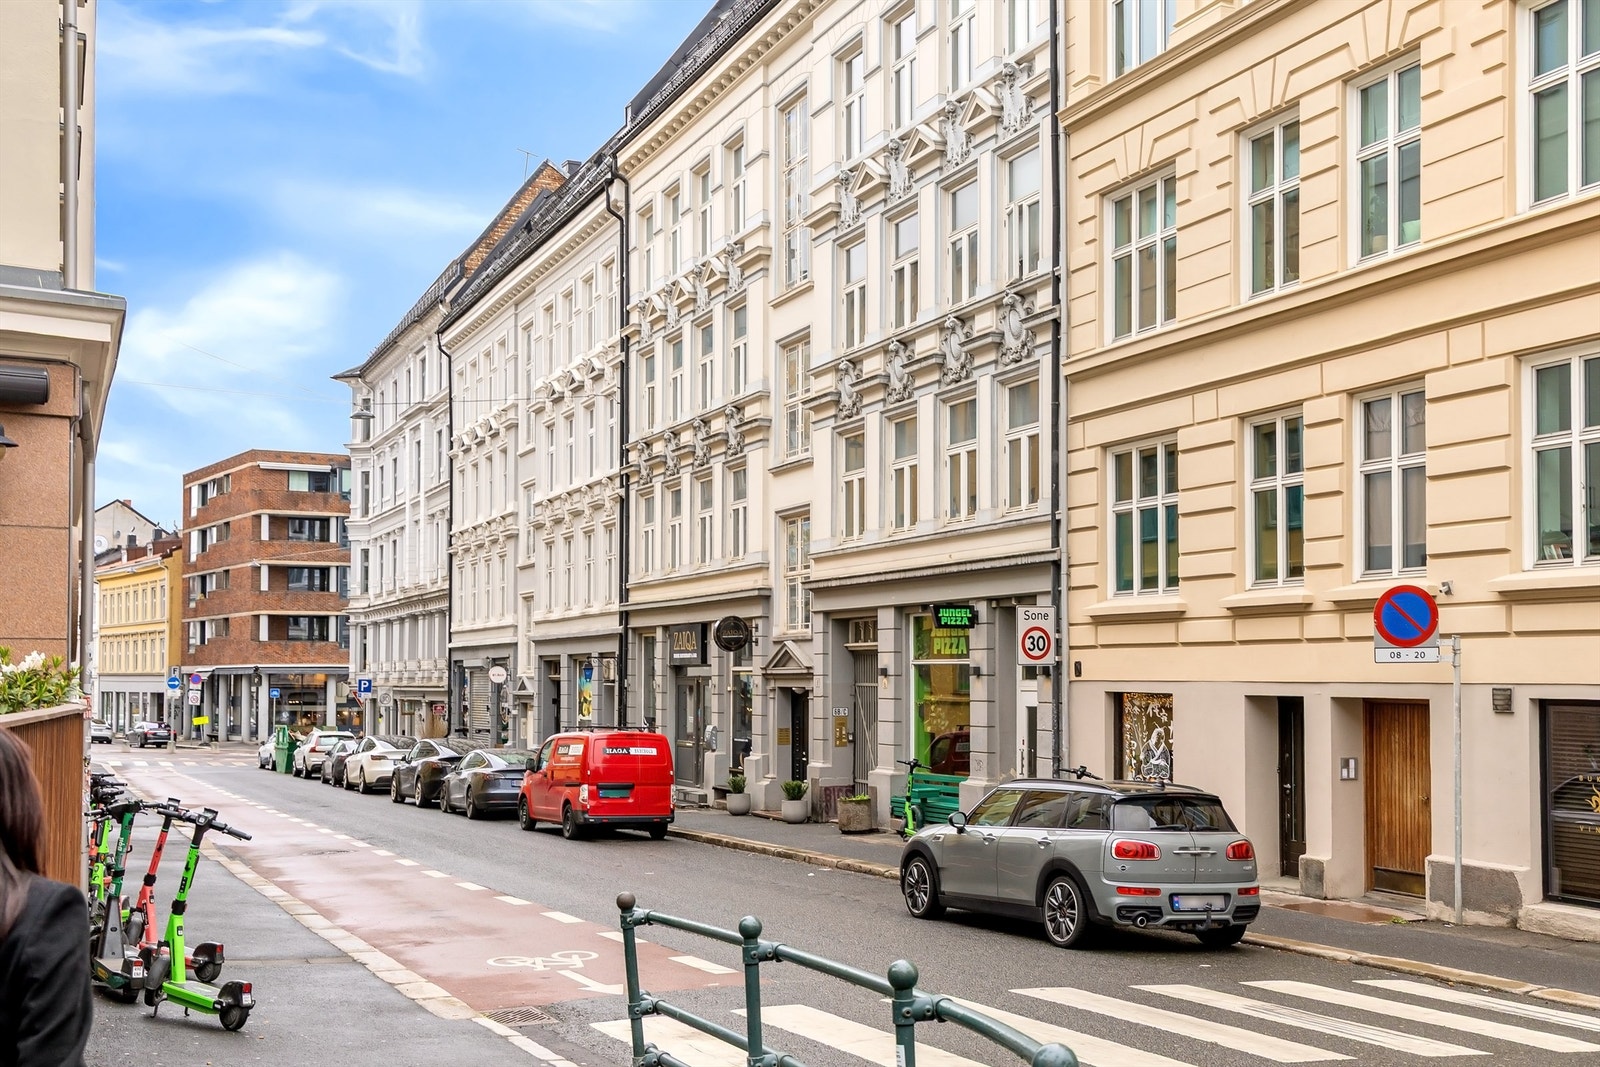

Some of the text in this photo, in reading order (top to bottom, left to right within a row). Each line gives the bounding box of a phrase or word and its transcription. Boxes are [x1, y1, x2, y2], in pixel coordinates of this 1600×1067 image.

[938, 608, 972, 617] JUNGEL
[1023, 610, 1049, 621] Sone
[941, 617, 969, 625] PIZZA
[673, 631, 697, 651] ZAIQA
[933, 637, 967, 654] PIZZA
[1027, 635, 1046, 652] 30
[1389, 651, 1402, 659] 08
[1414, 651, 1426, 659] 20
[361, 681, 369, 691] P
